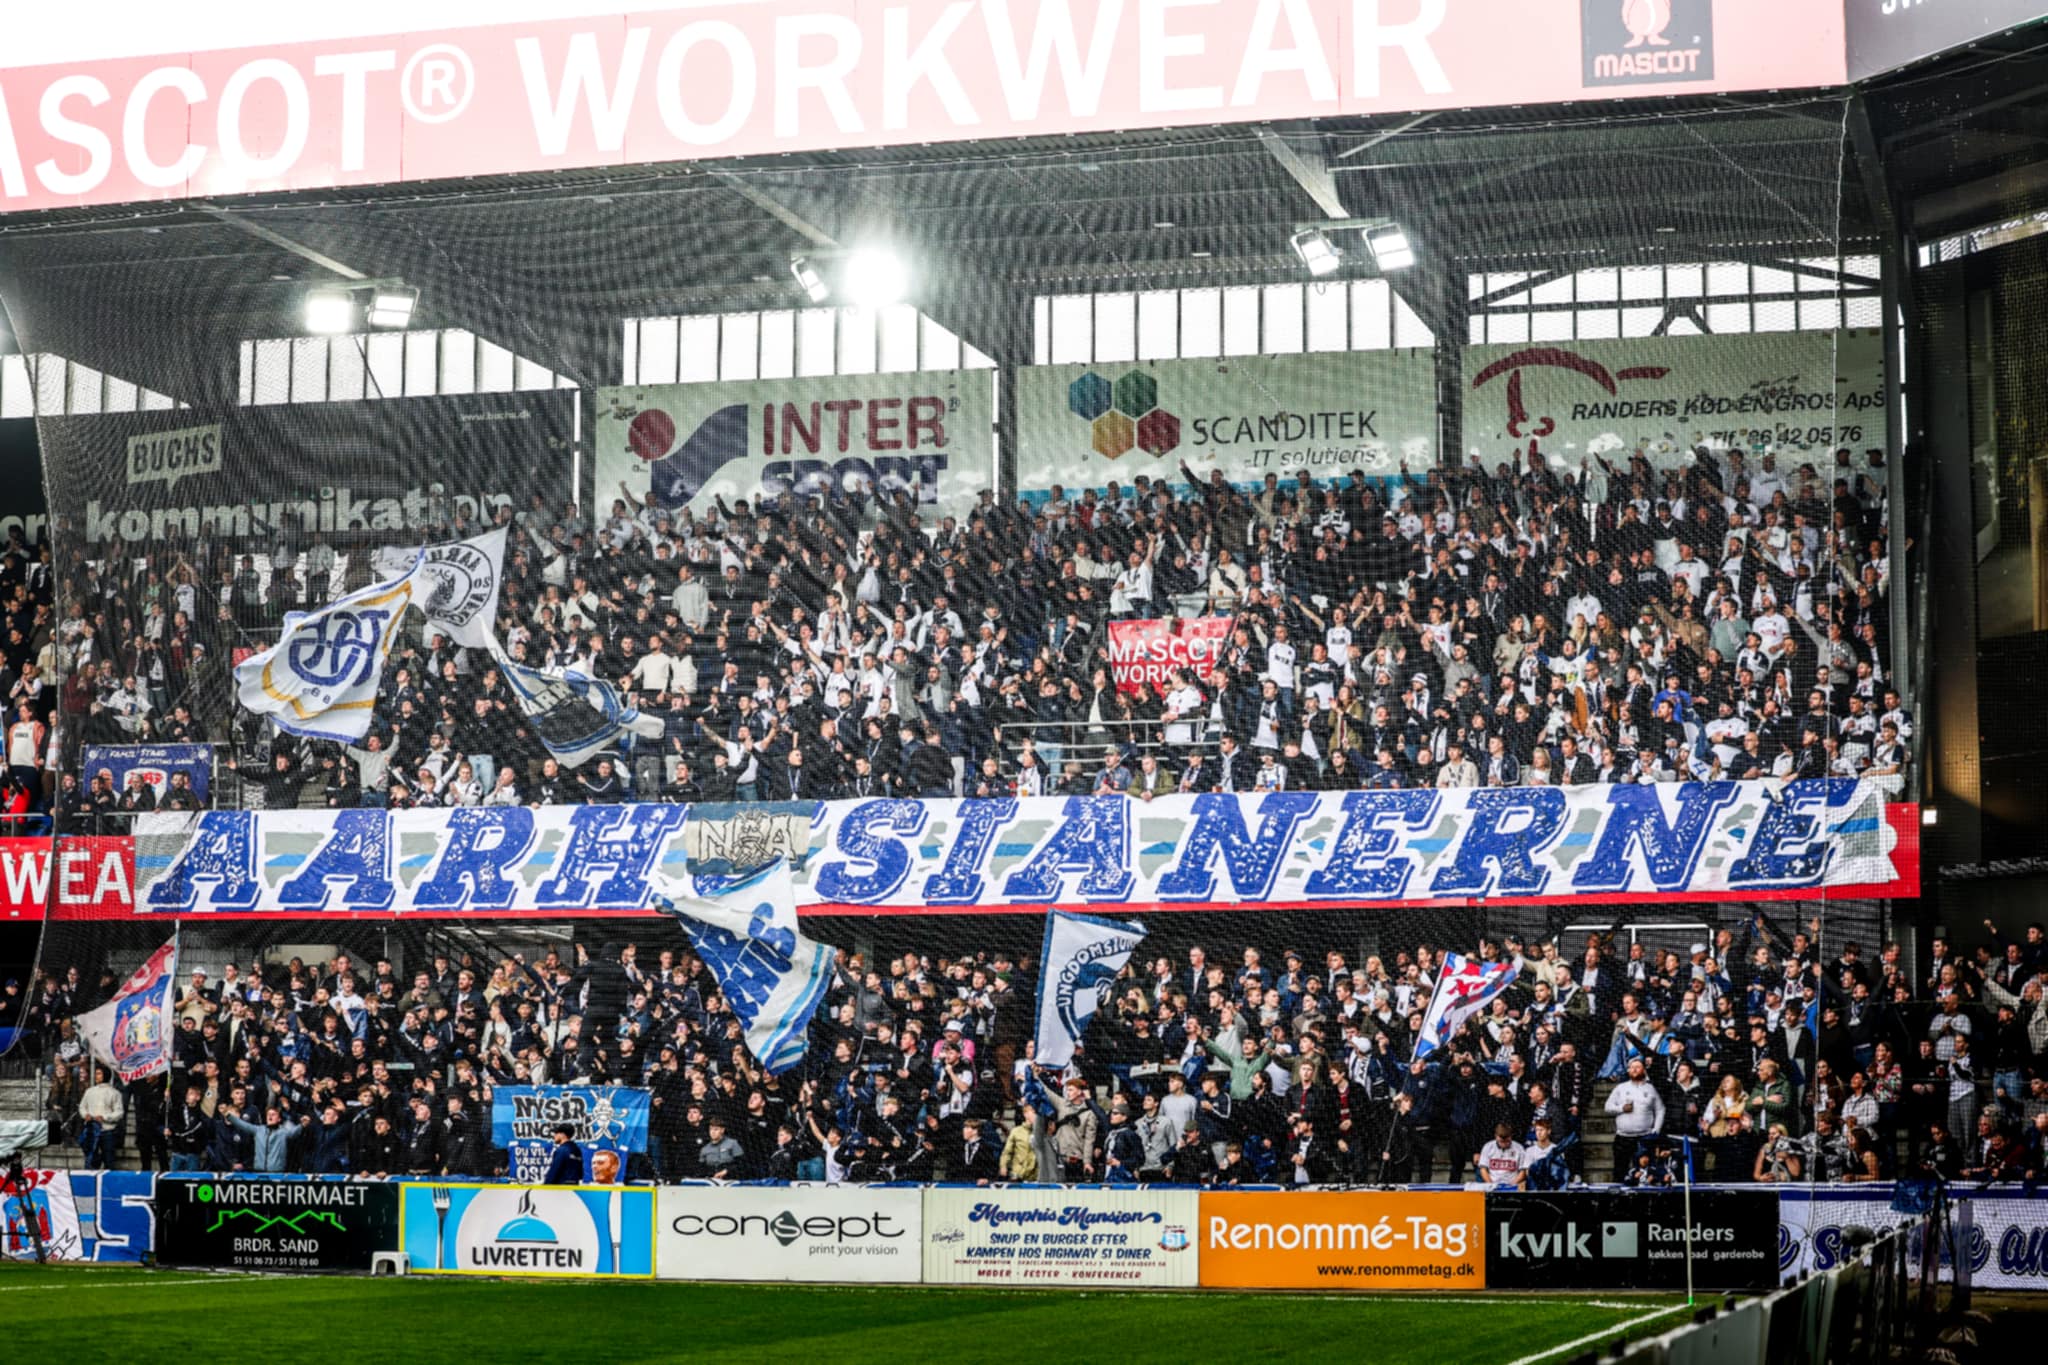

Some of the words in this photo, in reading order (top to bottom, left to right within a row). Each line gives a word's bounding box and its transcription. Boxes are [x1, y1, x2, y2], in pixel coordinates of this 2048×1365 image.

[1594, 50, 1701, 77] MASCOT
[514, 0, 1455, 156] WORKWEAR
[1572, 398, 1678, 420] RANDERS
[1775, 392, 1838, 412] GROS
[1844, 390, 1886, 411] ApS
[763, 397, 946, 456] INTER
[1193, 410, 1378, 445] SCANDITEK
[1839, 425, 1863, 442] 76
[133, 433, 216, 475] BUCHS
[1280, 447, 1377, 467] solutions
[1108, 637, 1224, 663] MASCOT
[1112, 662, 1212, 684] WORKE
[148, 778, 1861, 912] AARHSIANERNE
[968, 1202, 1057, 1227] Memphis
[1058, 1206, 1162, 1230] Mansion
[990, 1232, 1020, 1245] SNUP
[1024, 1233, 1039, 1245] EN
[1043, 1233, 1090, 1246] BURGER
[1092, 1233, 1128, 1245] EFTER
[1209, 1215, 1467, 1257] Renommé-Tag
[1500, 1222, 1593, 1258] kvik
[1648, 1222, 1735, 1242] Randers
[233, 1237, 275, 1252] BRDR.
[279, 1238, 319, 1253] SAND
[809, 1243, 831, 1257] print
[834, 1245, 858, 1257] your
[861, 1244, 898, 1256] vision
[966, 1247, 1015, 1259] KAMPEN
[1018, 1247, 1042, 1259] HOS
[1044, 1247, 1098, 1260] HIGHWAY
[1101, 1248, 1113, 1259] 51
[1116, 1248, 1152, 1260] DINER
[1648, 1249, 1684, 1259] køkken
[1713, 1250, 1765, 1261] garderobe
[472, 1247, 583, 1268] LIVRETTEN
[977, 1269, 1012, 1278] MØDER
[1024, 1270, 1060, 1279] FESTER
[1072, 1270, 1142, 1280] KONFERENCER
[1317, 1263, 1475, 1279] www.renommetag.dk
